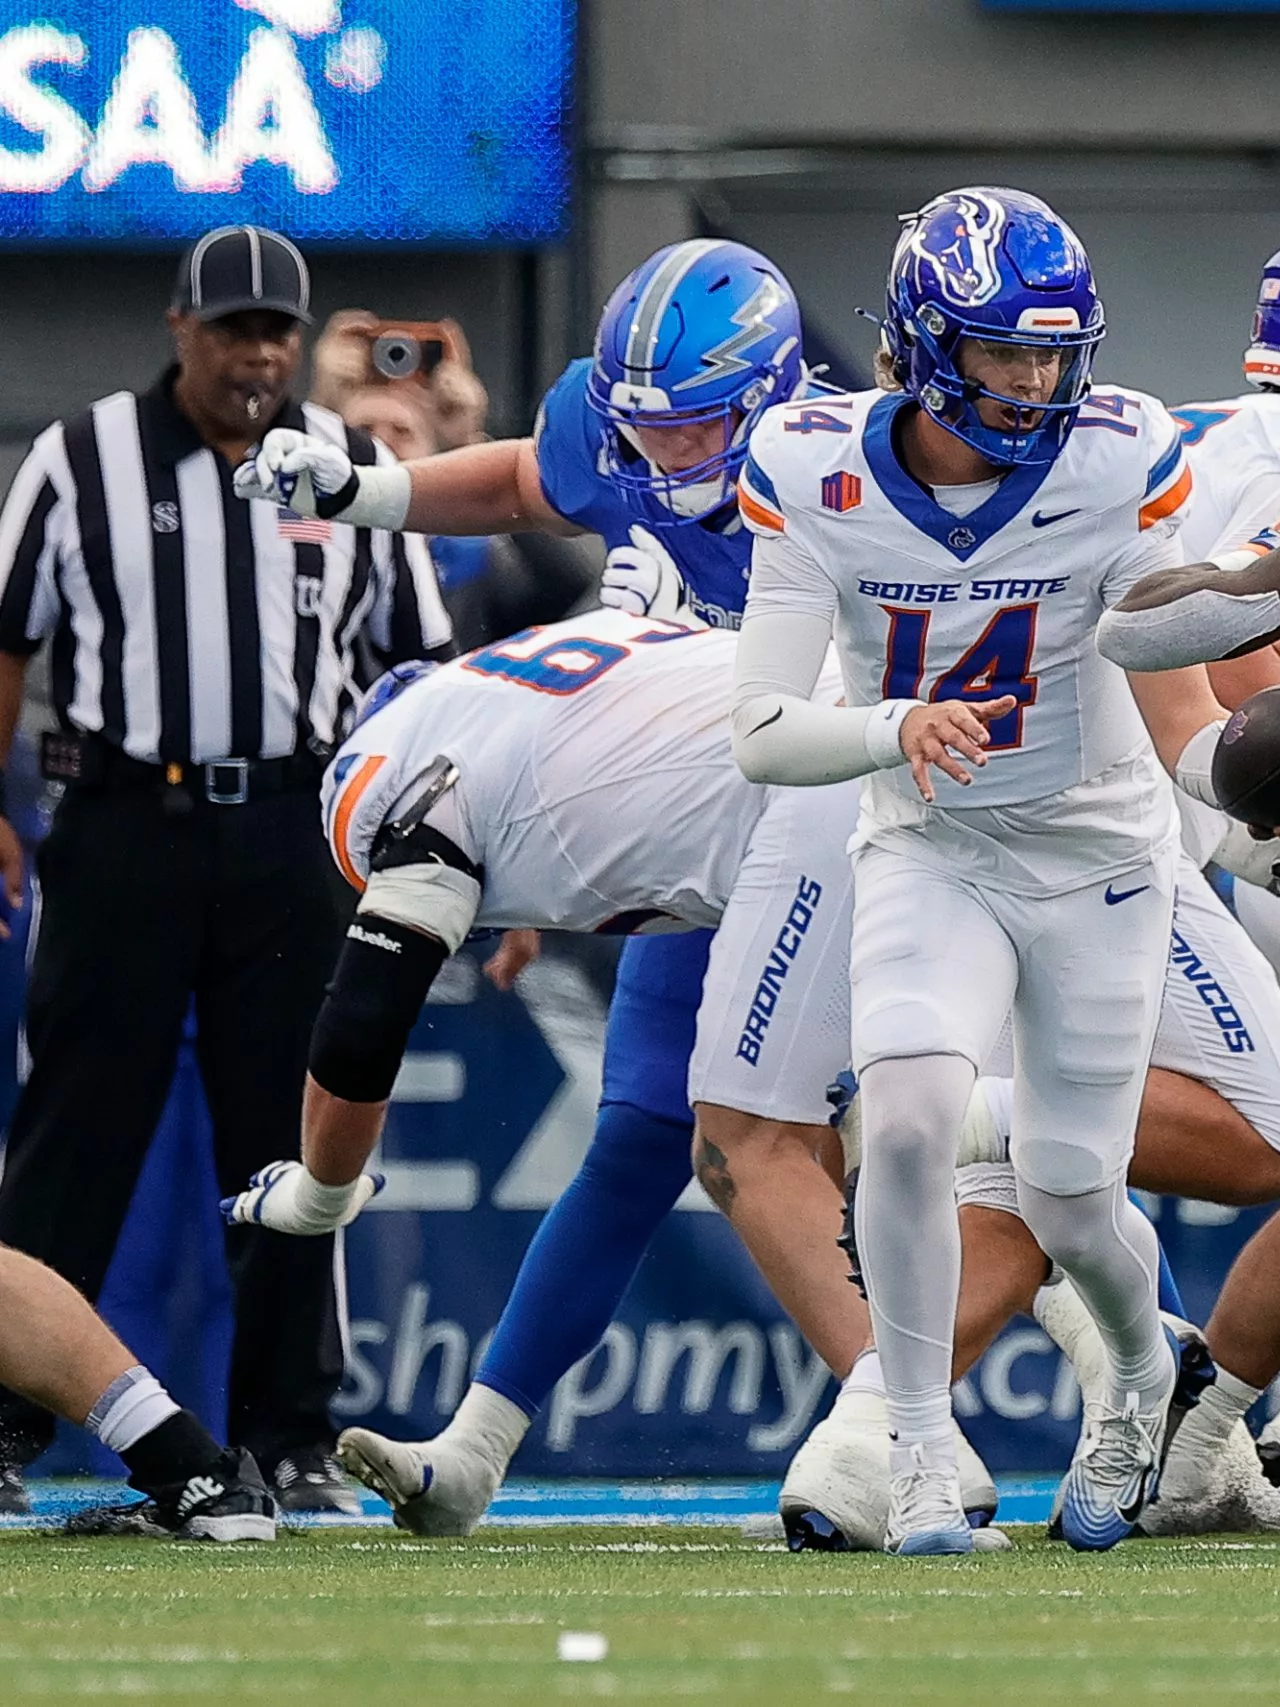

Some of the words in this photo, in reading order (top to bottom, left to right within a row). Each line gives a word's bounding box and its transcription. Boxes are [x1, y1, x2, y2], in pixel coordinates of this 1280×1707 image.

[857, 578, 962, 603] BOISE
[968, 575, 1072, 601] STATE
[877, 601, 1039, 752] 14
[735, 875, 823, 1067] BRONCOS
[1171, 886, 1256, 1053] ONCOS
